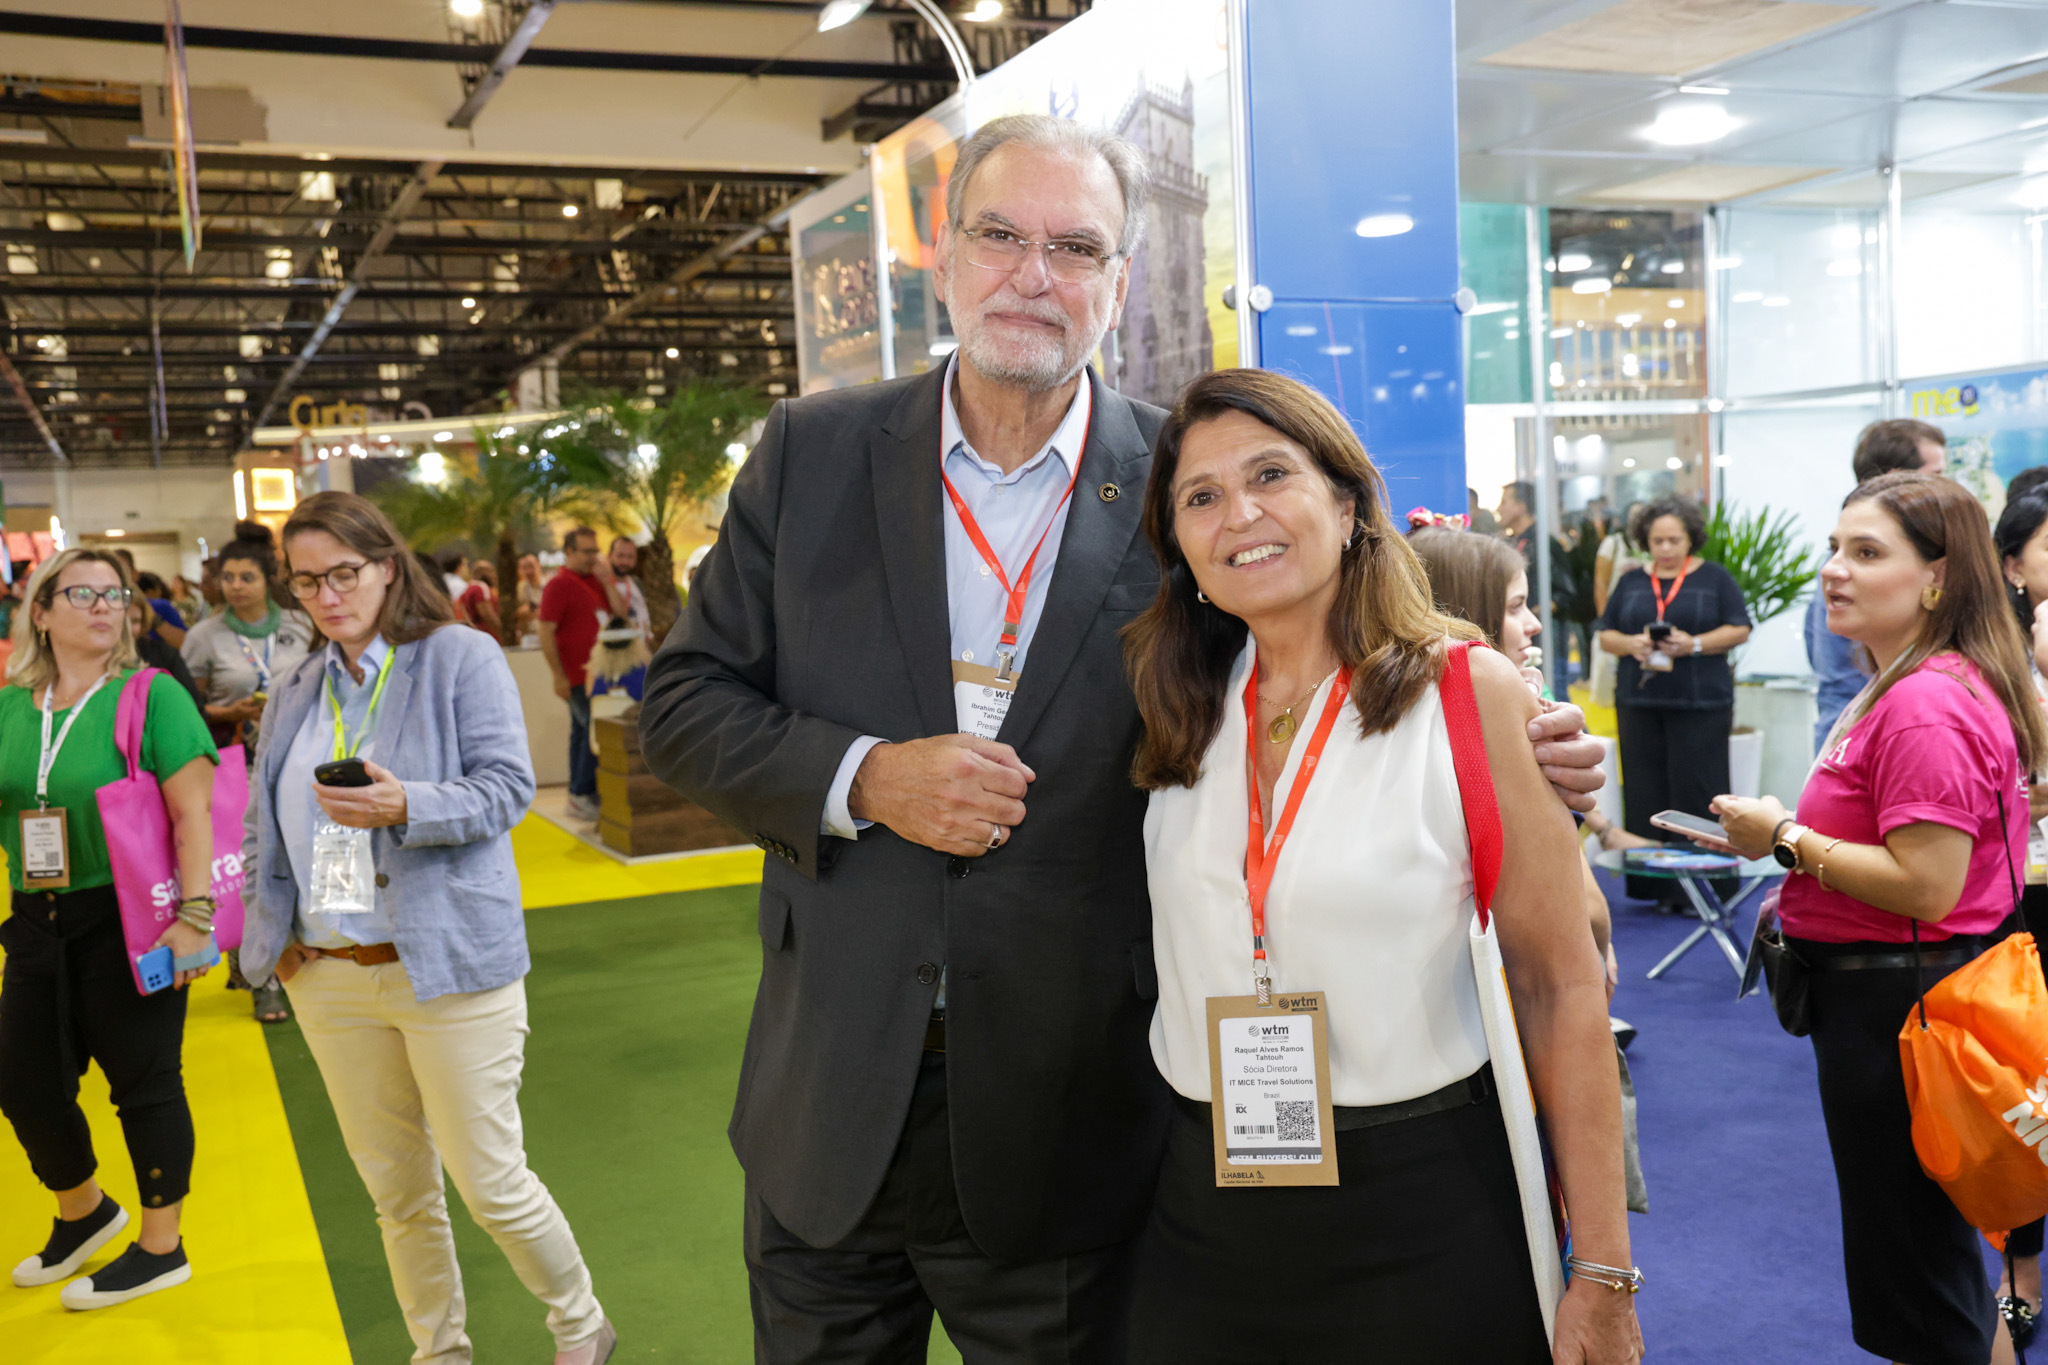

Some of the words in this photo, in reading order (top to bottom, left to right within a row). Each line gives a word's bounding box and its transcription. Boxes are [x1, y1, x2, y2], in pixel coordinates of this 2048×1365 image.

[995, 690, 1012, 700] wt
[971, 703, 995, 713] Ibrahim
[983, 712, 1004, 721] Tahtou
[977, 721, 1000, 731] Presid
[1291, 996, 1317, 1007] wtm
[1261, 1024, 1289, 1035] wtm
[1234, 1047, 1258, 1055] Raquel
[1243, 1065, 1265, 1074] Sócia
[1267, 1064, 1298, 1073] Diretora
